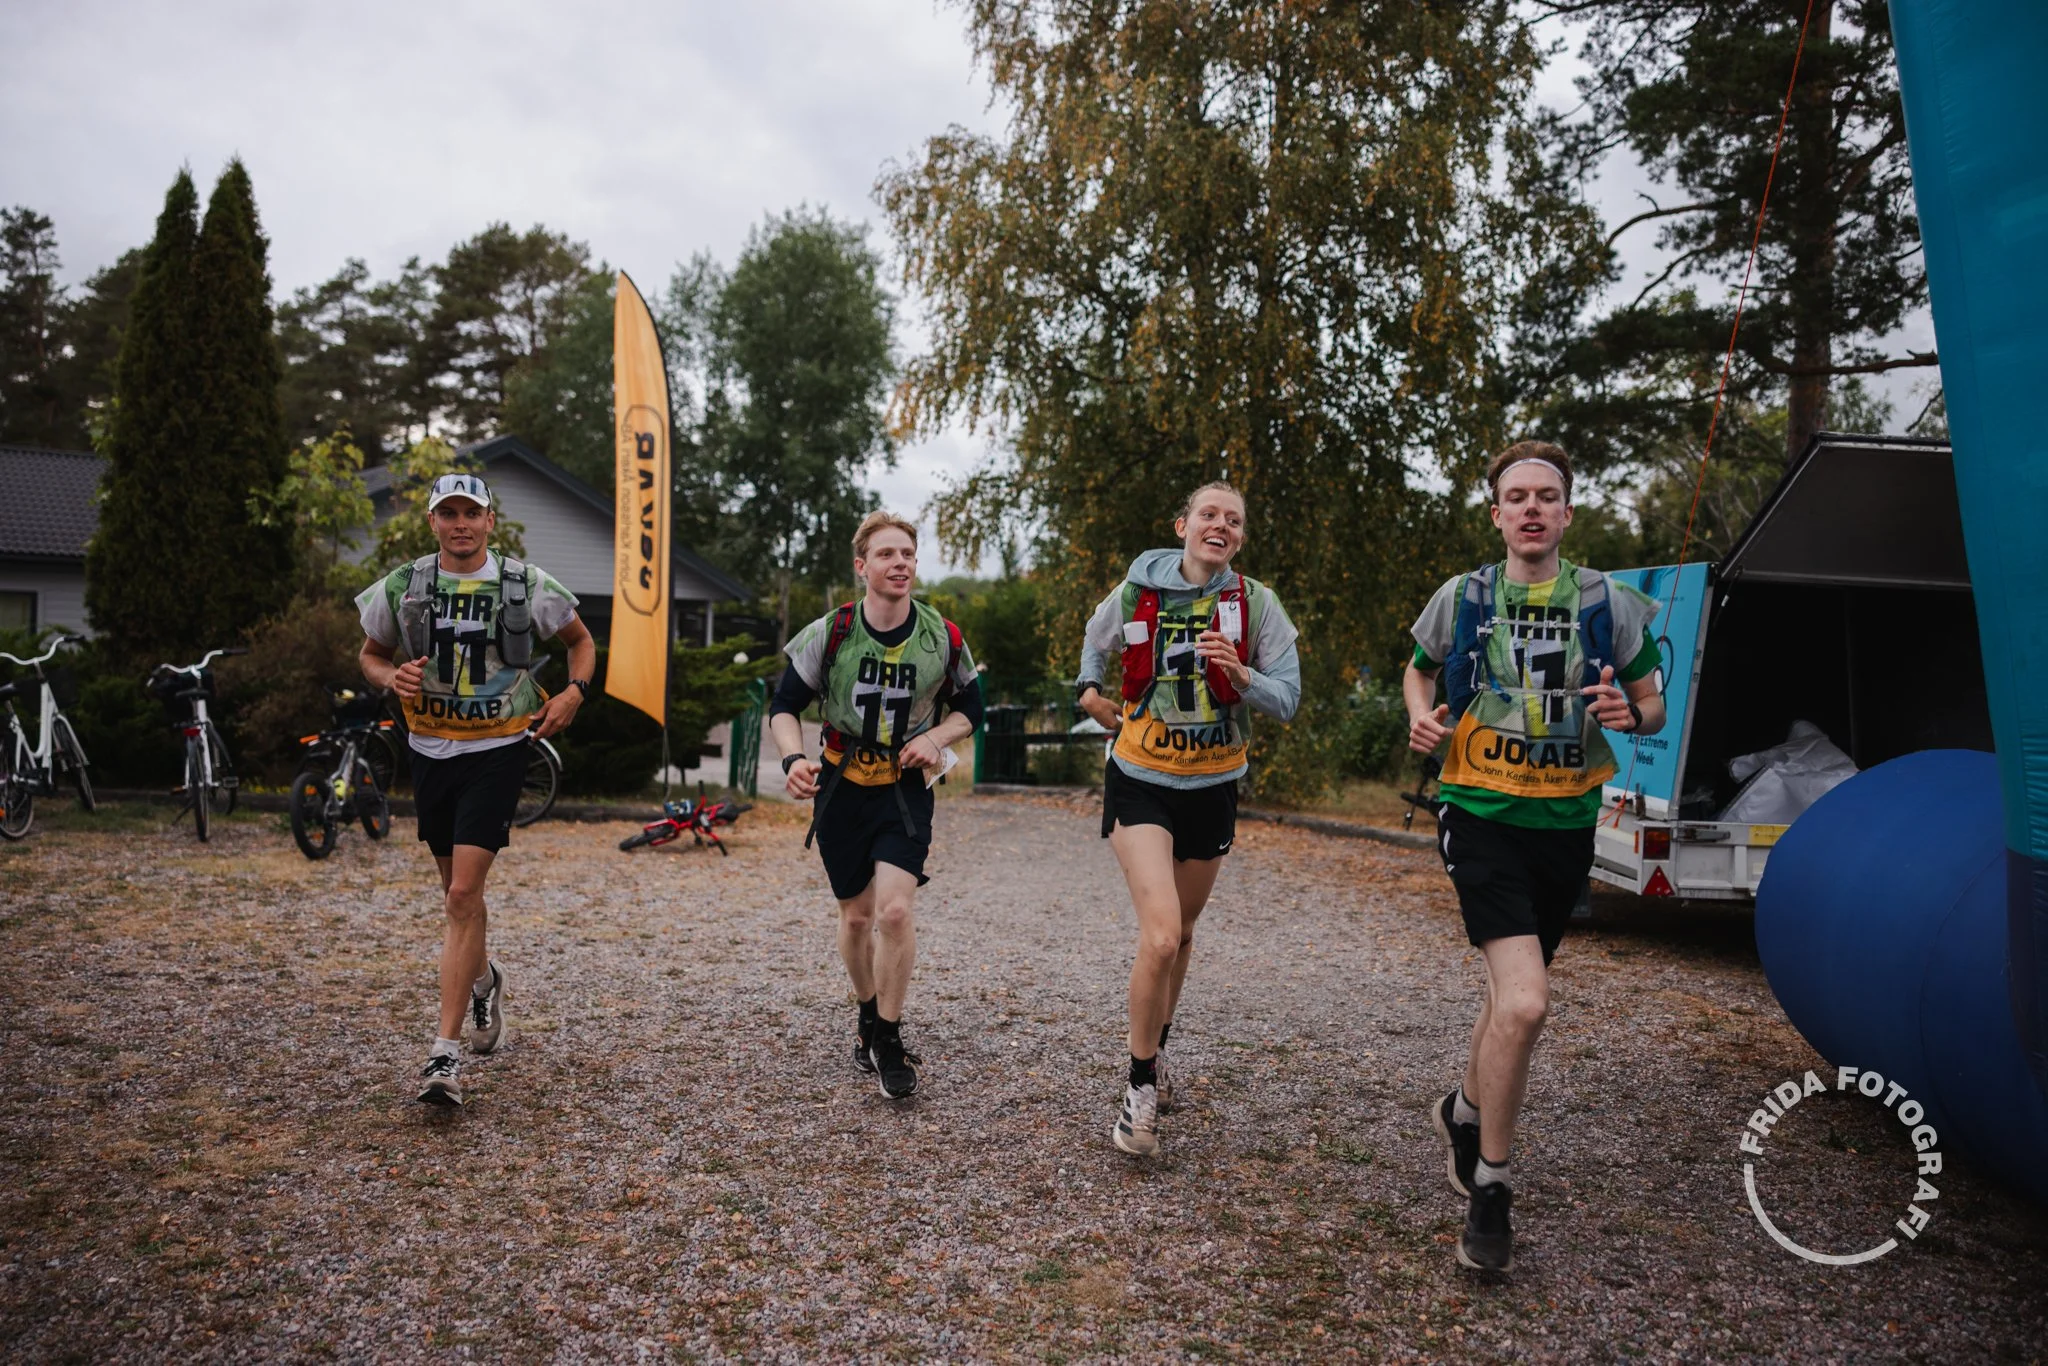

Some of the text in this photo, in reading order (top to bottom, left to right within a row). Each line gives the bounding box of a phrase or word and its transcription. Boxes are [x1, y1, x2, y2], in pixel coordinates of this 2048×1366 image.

[857, 652, 917, 691] ÖAR
[414, 696, 503, 721] JOKAB
[855, 692, 913, 748] 11
[1483, 735, 1586, 769] JOKAB
[1480, 763, 1502, 776] John
